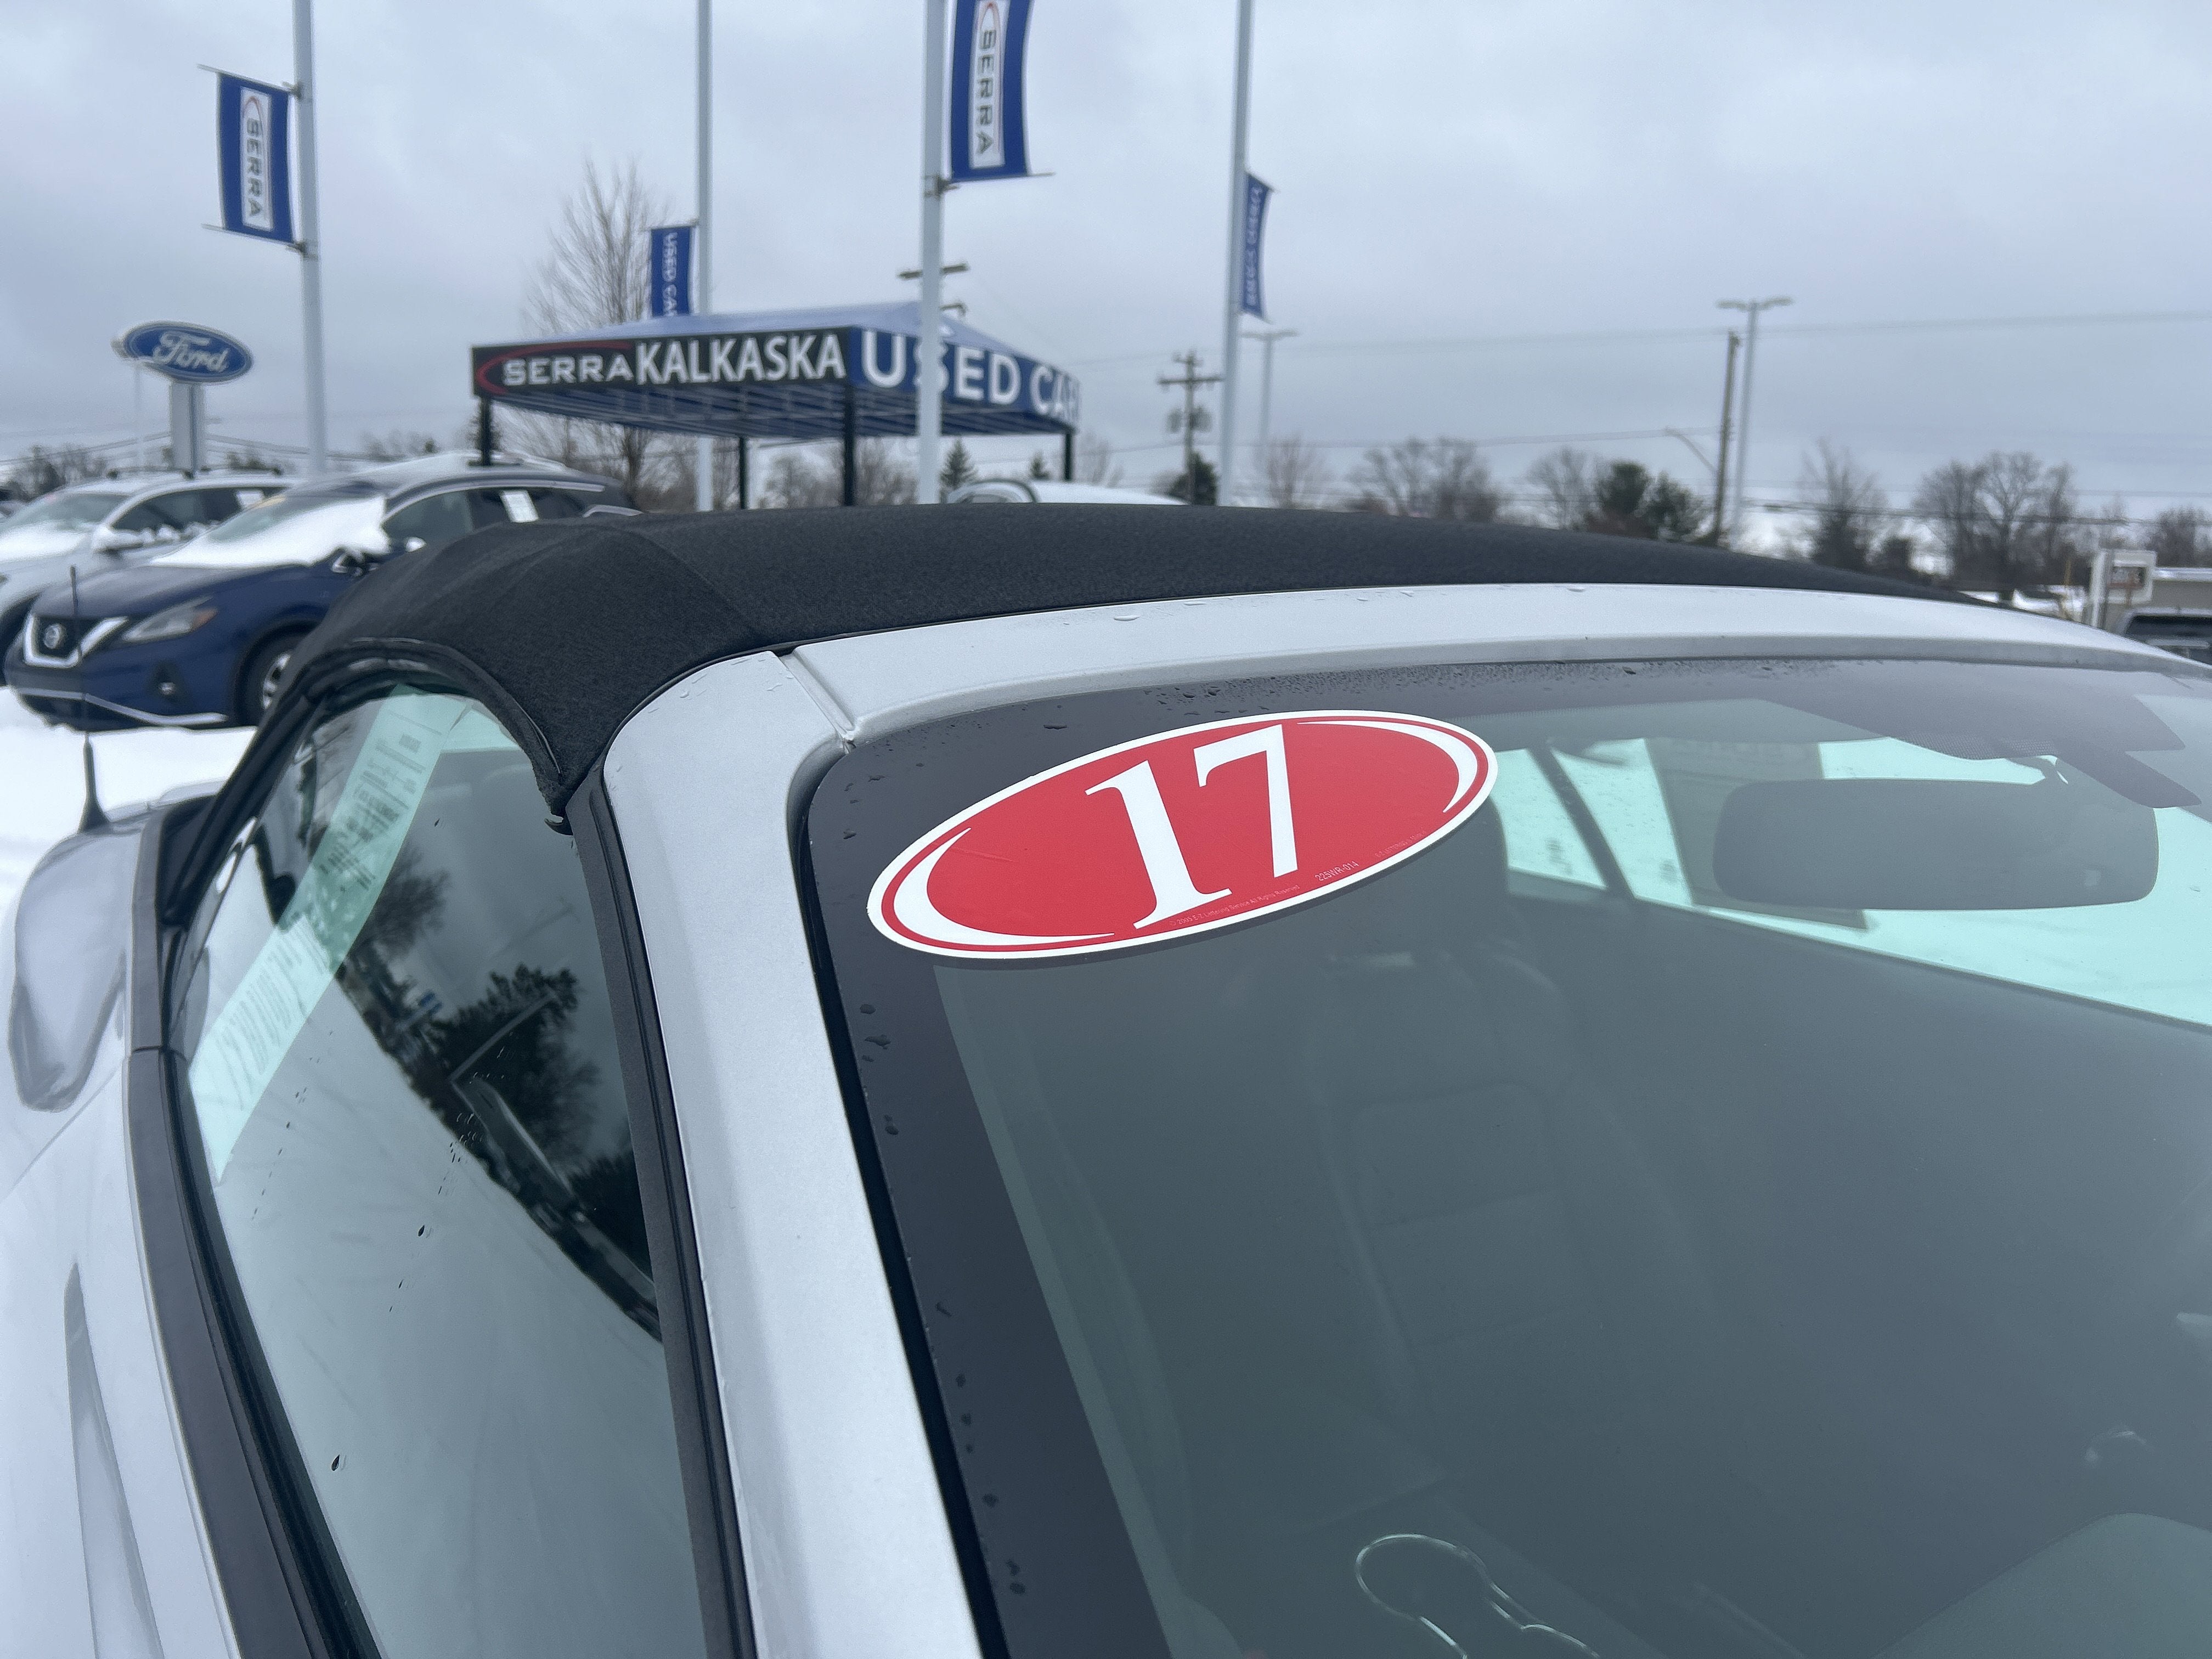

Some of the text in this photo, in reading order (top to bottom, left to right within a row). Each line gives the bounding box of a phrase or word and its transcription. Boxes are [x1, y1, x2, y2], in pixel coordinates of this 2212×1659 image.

[975, 29, 997, 154] SERRA
[247, 117, 262, 216] SERRA
[662, 233, 678, 282] USED
[153, 331, 230, 373] Ford
[503, 332, 848, 386] SERRA KALKASKA
[1085, 724, 1299, 929] 17
[1314, 860, 1359, 881] 225WR-014
[1176, 917, 1193, 925] 2005
